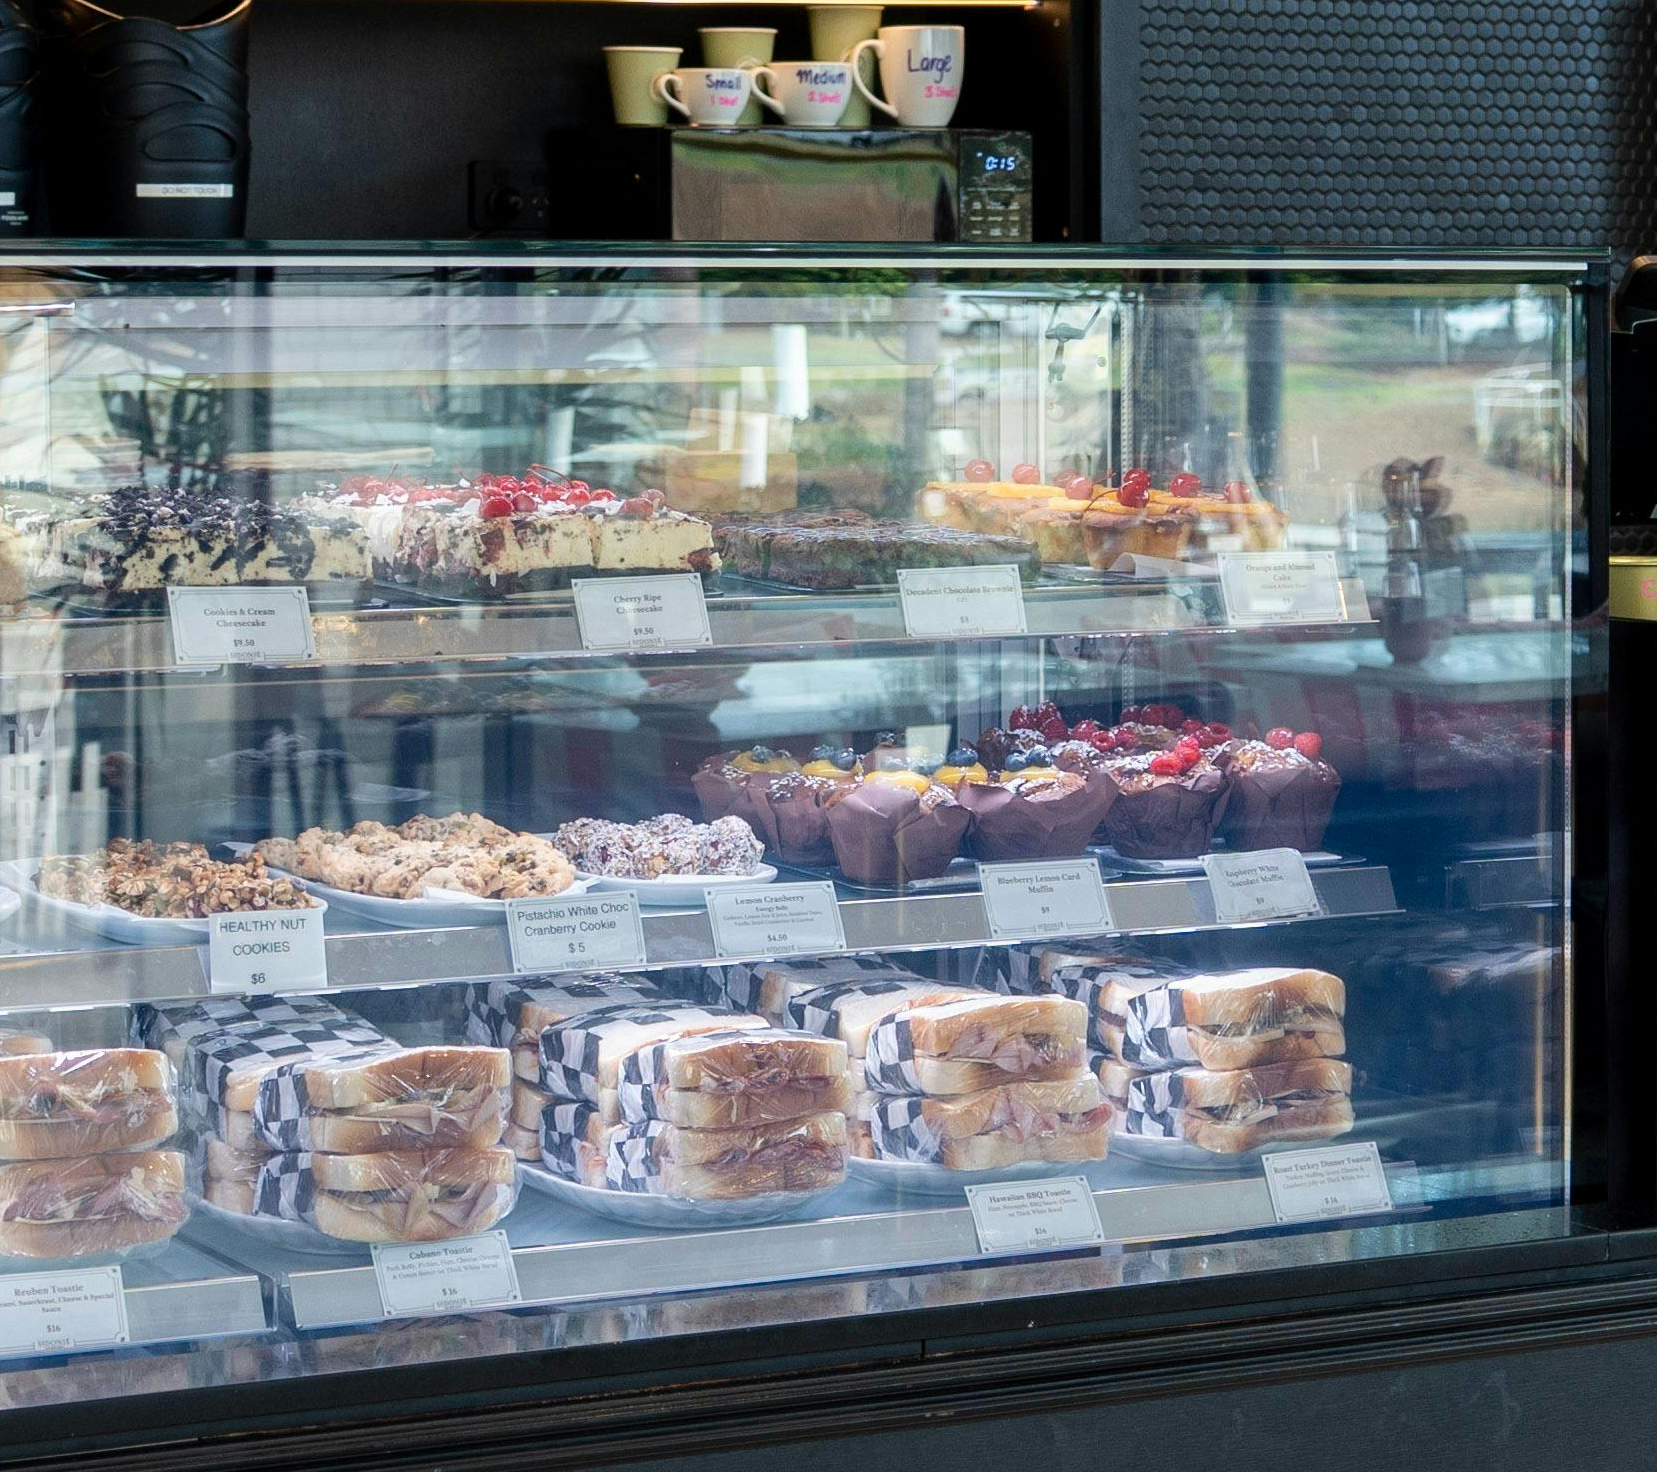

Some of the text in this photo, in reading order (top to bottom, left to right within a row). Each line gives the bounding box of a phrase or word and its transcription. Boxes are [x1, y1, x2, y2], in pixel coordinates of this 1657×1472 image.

[907, 50, 952, 83] Large
[705, 73, 742, 90] Small
[796, 69, 847, 85] Medium
[517, 901, 629, 922] Pistachio White Choc
[219, 918, 307, 933] HEALTHY NUT
[524, 920, 617, 937] Cranberry Cookie
[232, 941, 291, 956] COOKIES
[251, 972, 267, 985] $6
